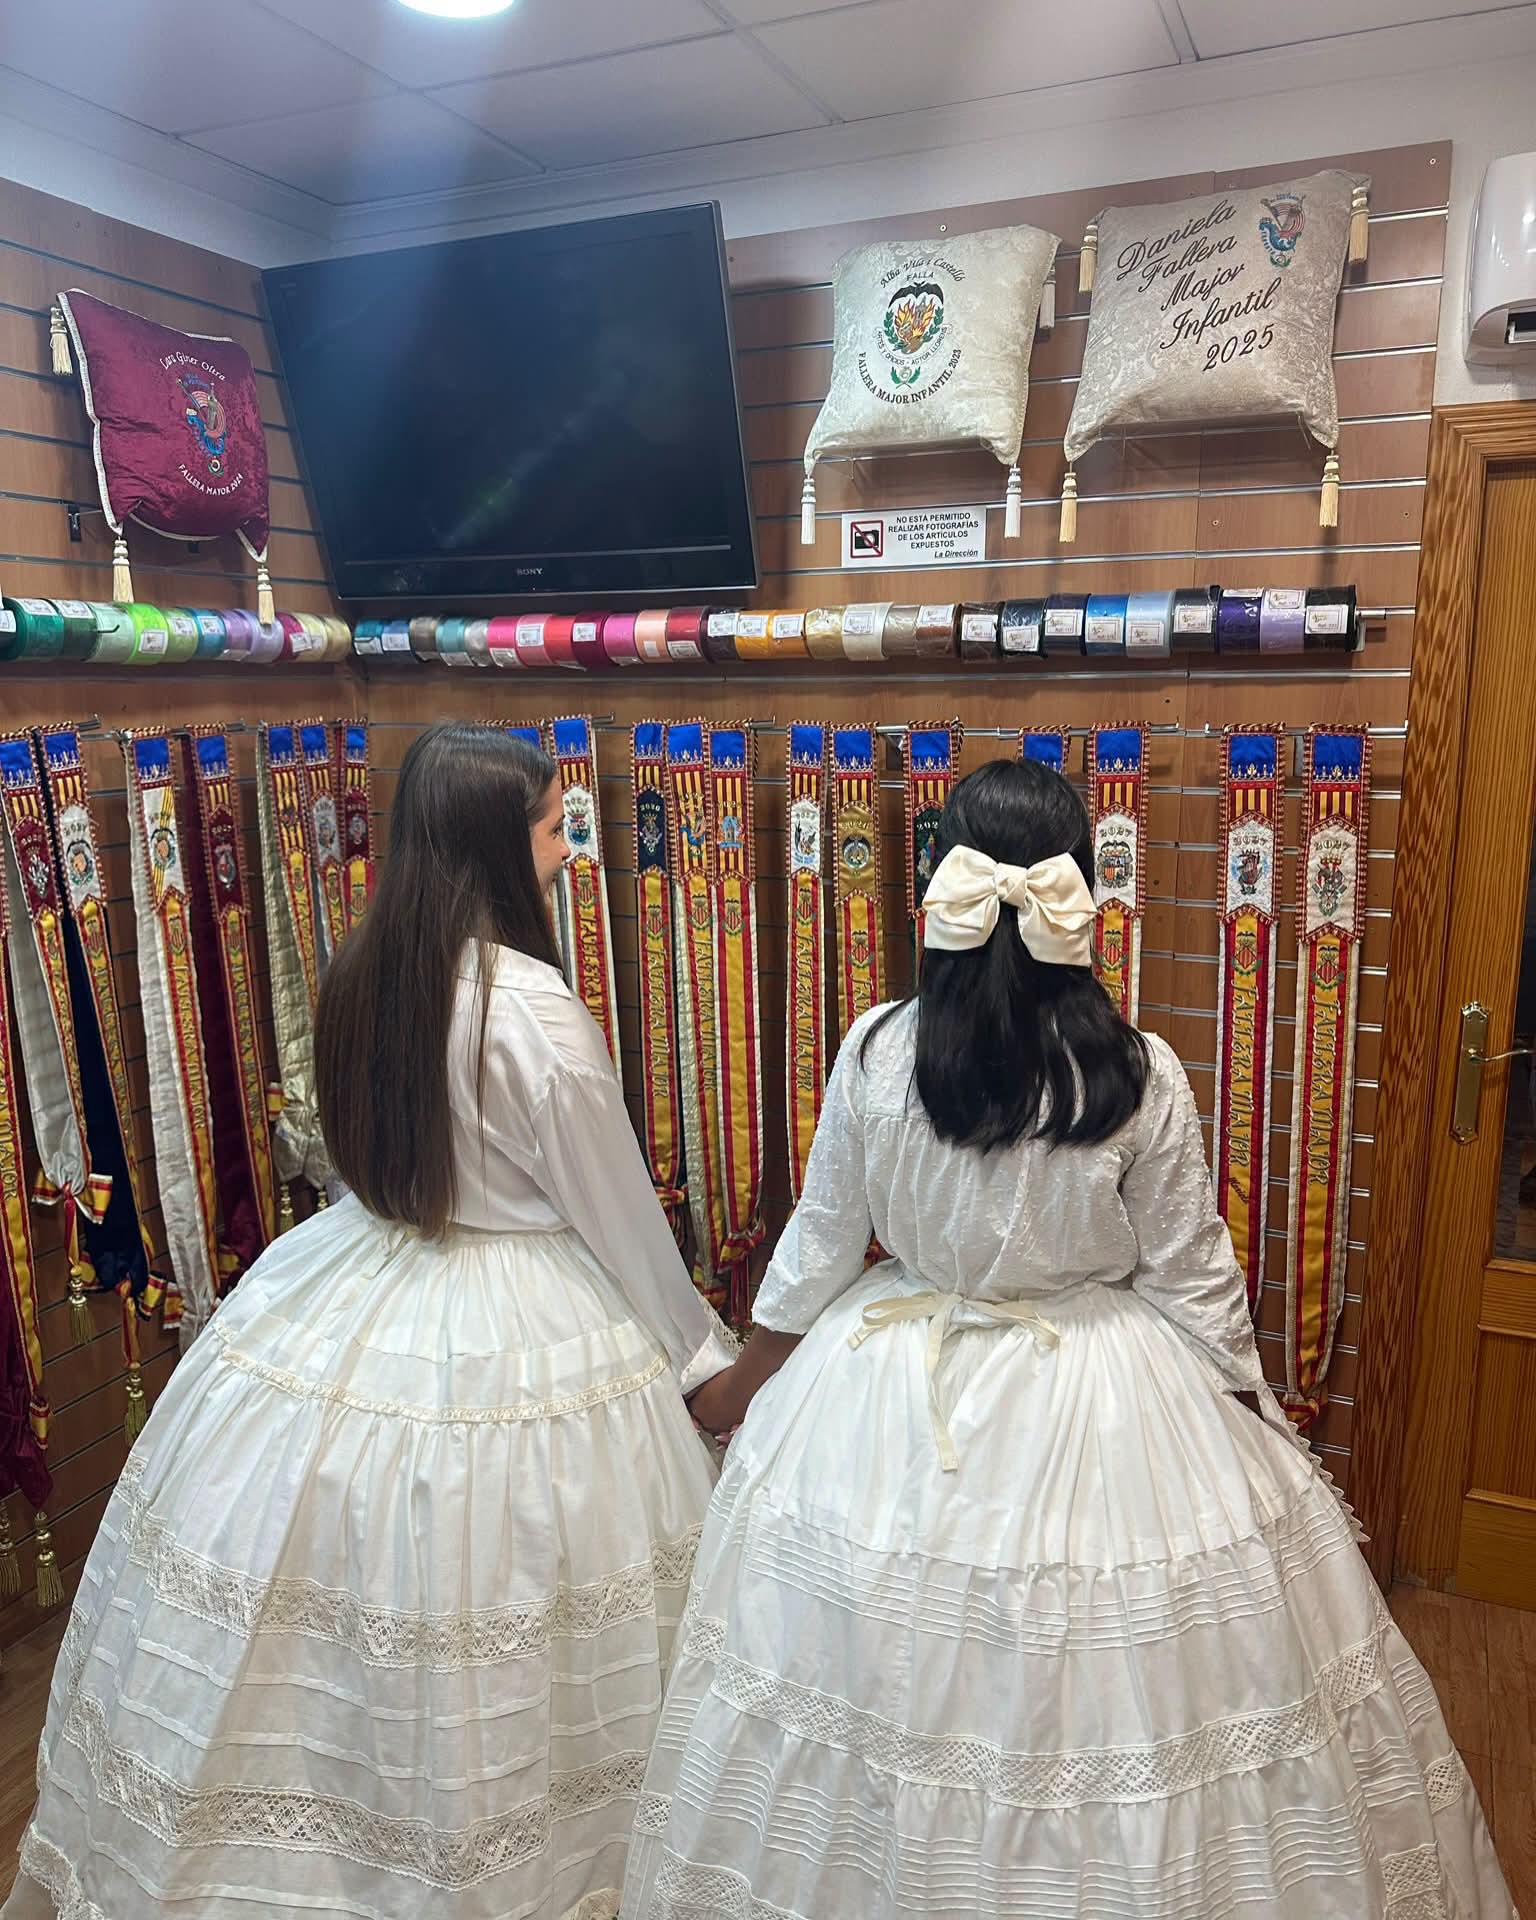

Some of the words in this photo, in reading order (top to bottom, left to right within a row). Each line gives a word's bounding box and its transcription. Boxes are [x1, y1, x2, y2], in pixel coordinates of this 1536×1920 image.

[1116, 199, 1237, 281] Daniela
[1138, 235, 1238, 292] Fallera
[880, 269, 900, 288] Alba
[934, 257, 966, 282] Castelló
[906, 271, 934, 281] FALLA
[1160, 262, 1246, 311] Major
[1160, 277, 1282, 349] Infantil
[201, 361, 226, 381] Oltra
[911, 351, 931, 365] ACTOR
[1202, 323, 1275, 373] 2025
[857, 351, 877, 395] FALLERA
[876, 387, 910, 405] MAJOR
[911, 367, 953, 403] INFANTIL
[948, 348, 962, 369] 2023
[178, 463, 205, 492] FALLERA
[206, 485, 231, 496] MAYOR
[888, 524, 924, 533] REALIZAR
[896, 516, 907, 524] NO
[929, 512, 971, 522] PERMITIDO
[897, 533, 908, 541] DE
[909, 532, 925, 541] LOS
[910, 540, 955, 549] EXPUESTOS
[516, 567, 543, 576] SONY
[934, 551, 943, 559] La
[944, 549, 979, 558] Dirección
[646, 945, 669, 1031] FALLERA
[691, 937, 716, 1023] FALLERA
[795, 930, 816, 1021] FALLERA
[794, 1025, 816, 1092] MAJOR
[1231, 980, 1260, 1084] FALLERA
[1311, 994, 1342, 1101] FALLERA
[650, 1034, 671, 1098] MAJOR
[1226, 1089, 1254, 1167] MAJOR
[1305, 1103, 1335, 1186] MAJOR
